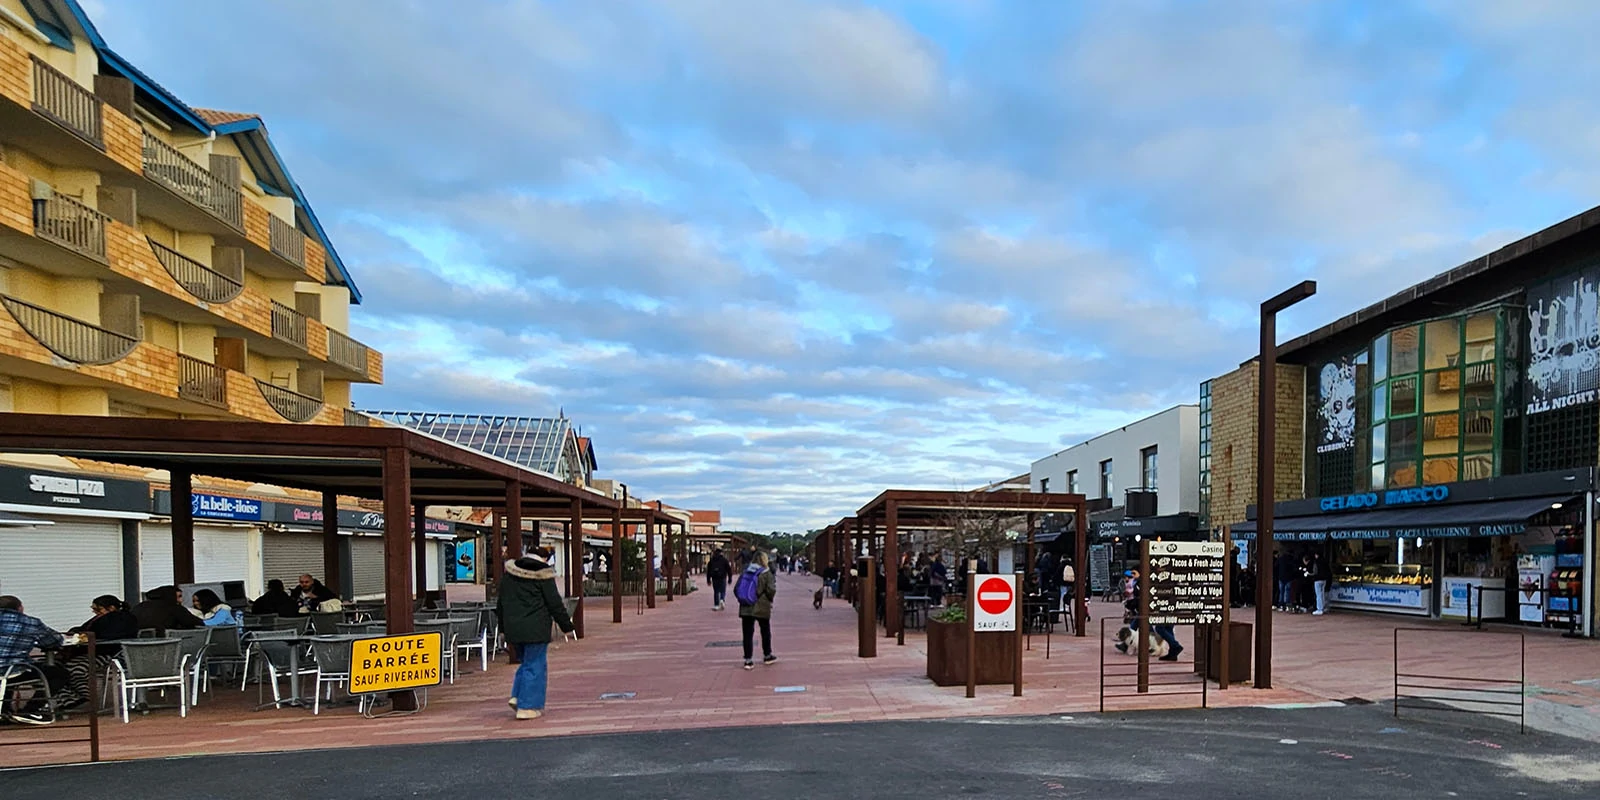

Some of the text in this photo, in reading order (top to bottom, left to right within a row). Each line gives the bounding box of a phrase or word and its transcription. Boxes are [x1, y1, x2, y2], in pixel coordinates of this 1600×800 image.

[1526, 401, 1550, 415] ALL
[1552, 390, 1594, 410] NIGHT
[1320, 485, 1449, 511] GELADO MARCO
[1202, 545, 1223, 553] Casino
[1171, 558, 1187, 567] Tacos
[1194, 558, 1208, 567] Fresh
[1209, 558, 1223, 568] Juice
[1188, 587, 1201, 595] Food
[978, 621, 997, 629] SAUF
[369, 639, 425, 653] ROUTE
[363, 653, 429, 669] BARRÉE
[355, 668, 436, 686] SAUF RIVERAINS
